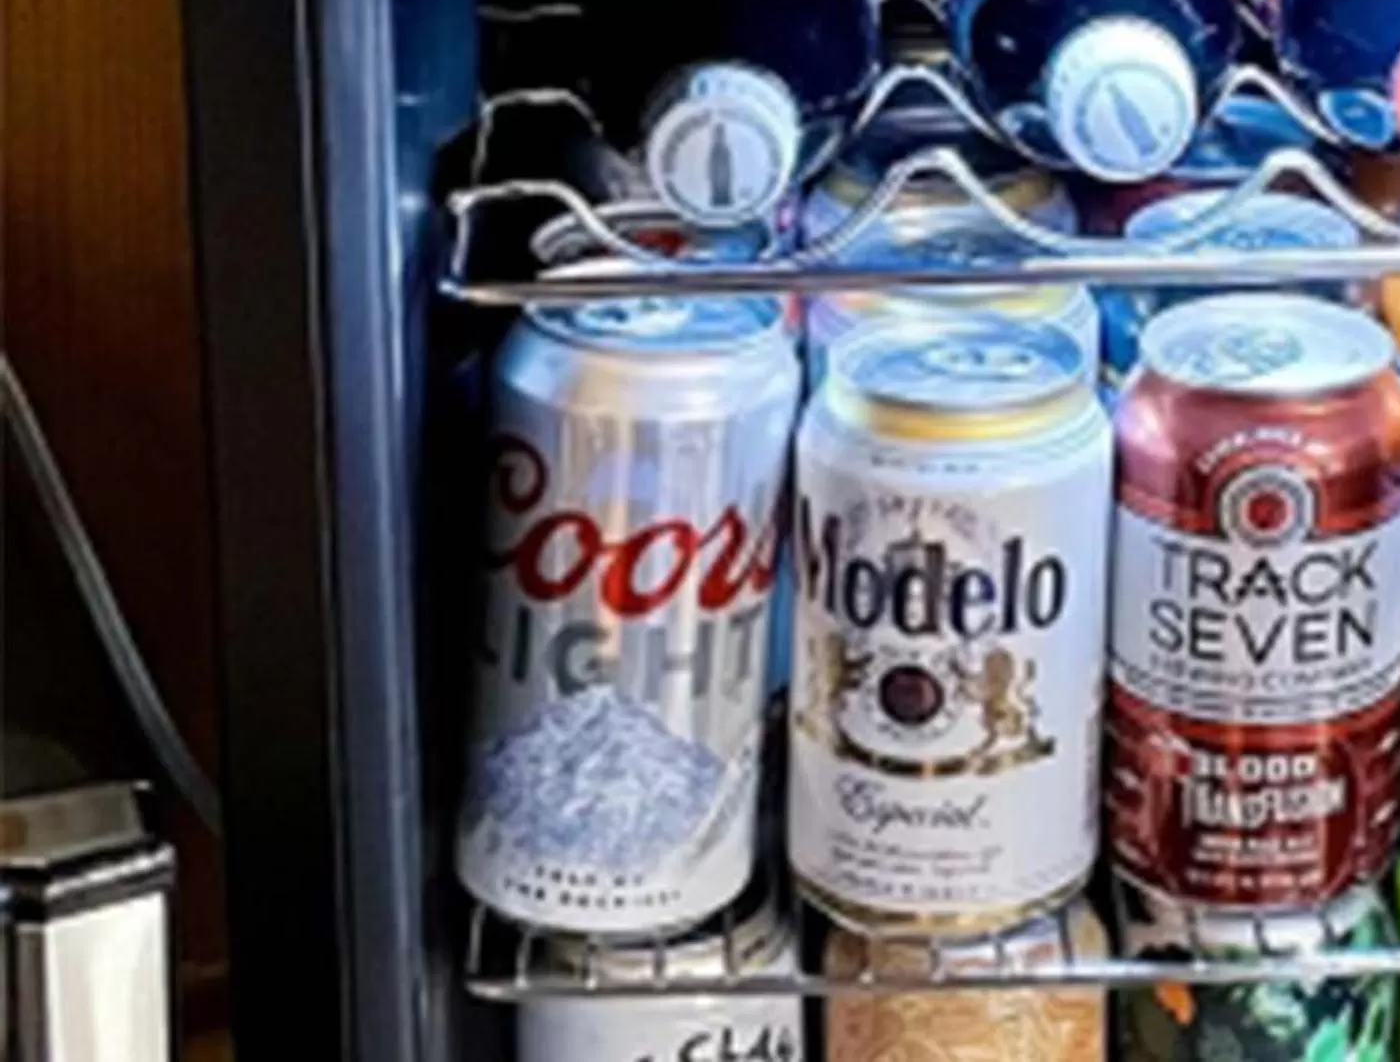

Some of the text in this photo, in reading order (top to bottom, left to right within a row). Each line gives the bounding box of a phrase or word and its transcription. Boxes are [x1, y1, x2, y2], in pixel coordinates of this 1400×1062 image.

[800, 495, 1067, 638] Modelo
[1150, 540, 1378, 607] TRACK
[480, 598, 764, 701] IGHT
[1148, 598, 1377, 666] SEVEN
